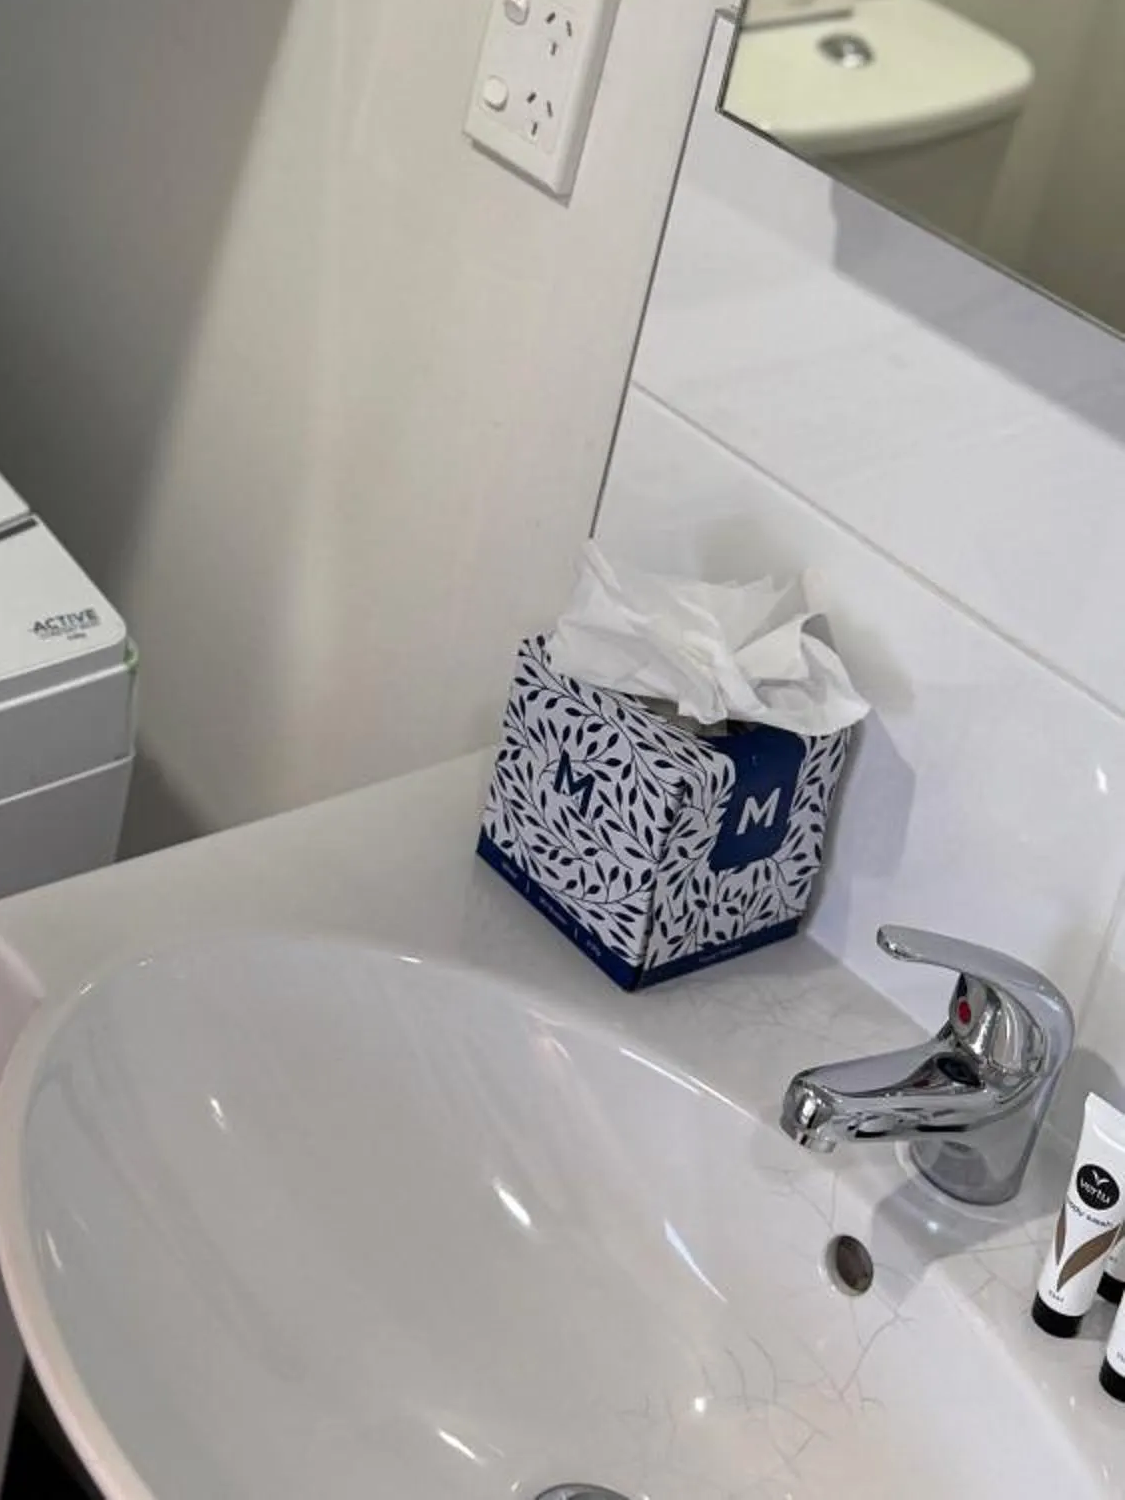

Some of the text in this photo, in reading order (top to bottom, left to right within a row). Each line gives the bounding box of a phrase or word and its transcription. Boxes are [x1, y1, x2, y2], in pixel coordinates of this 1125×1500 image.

[32, 607, 96, 633] ACTIVE
[553, 750, 596, 816] M
[737, 787, 781, 837] M
